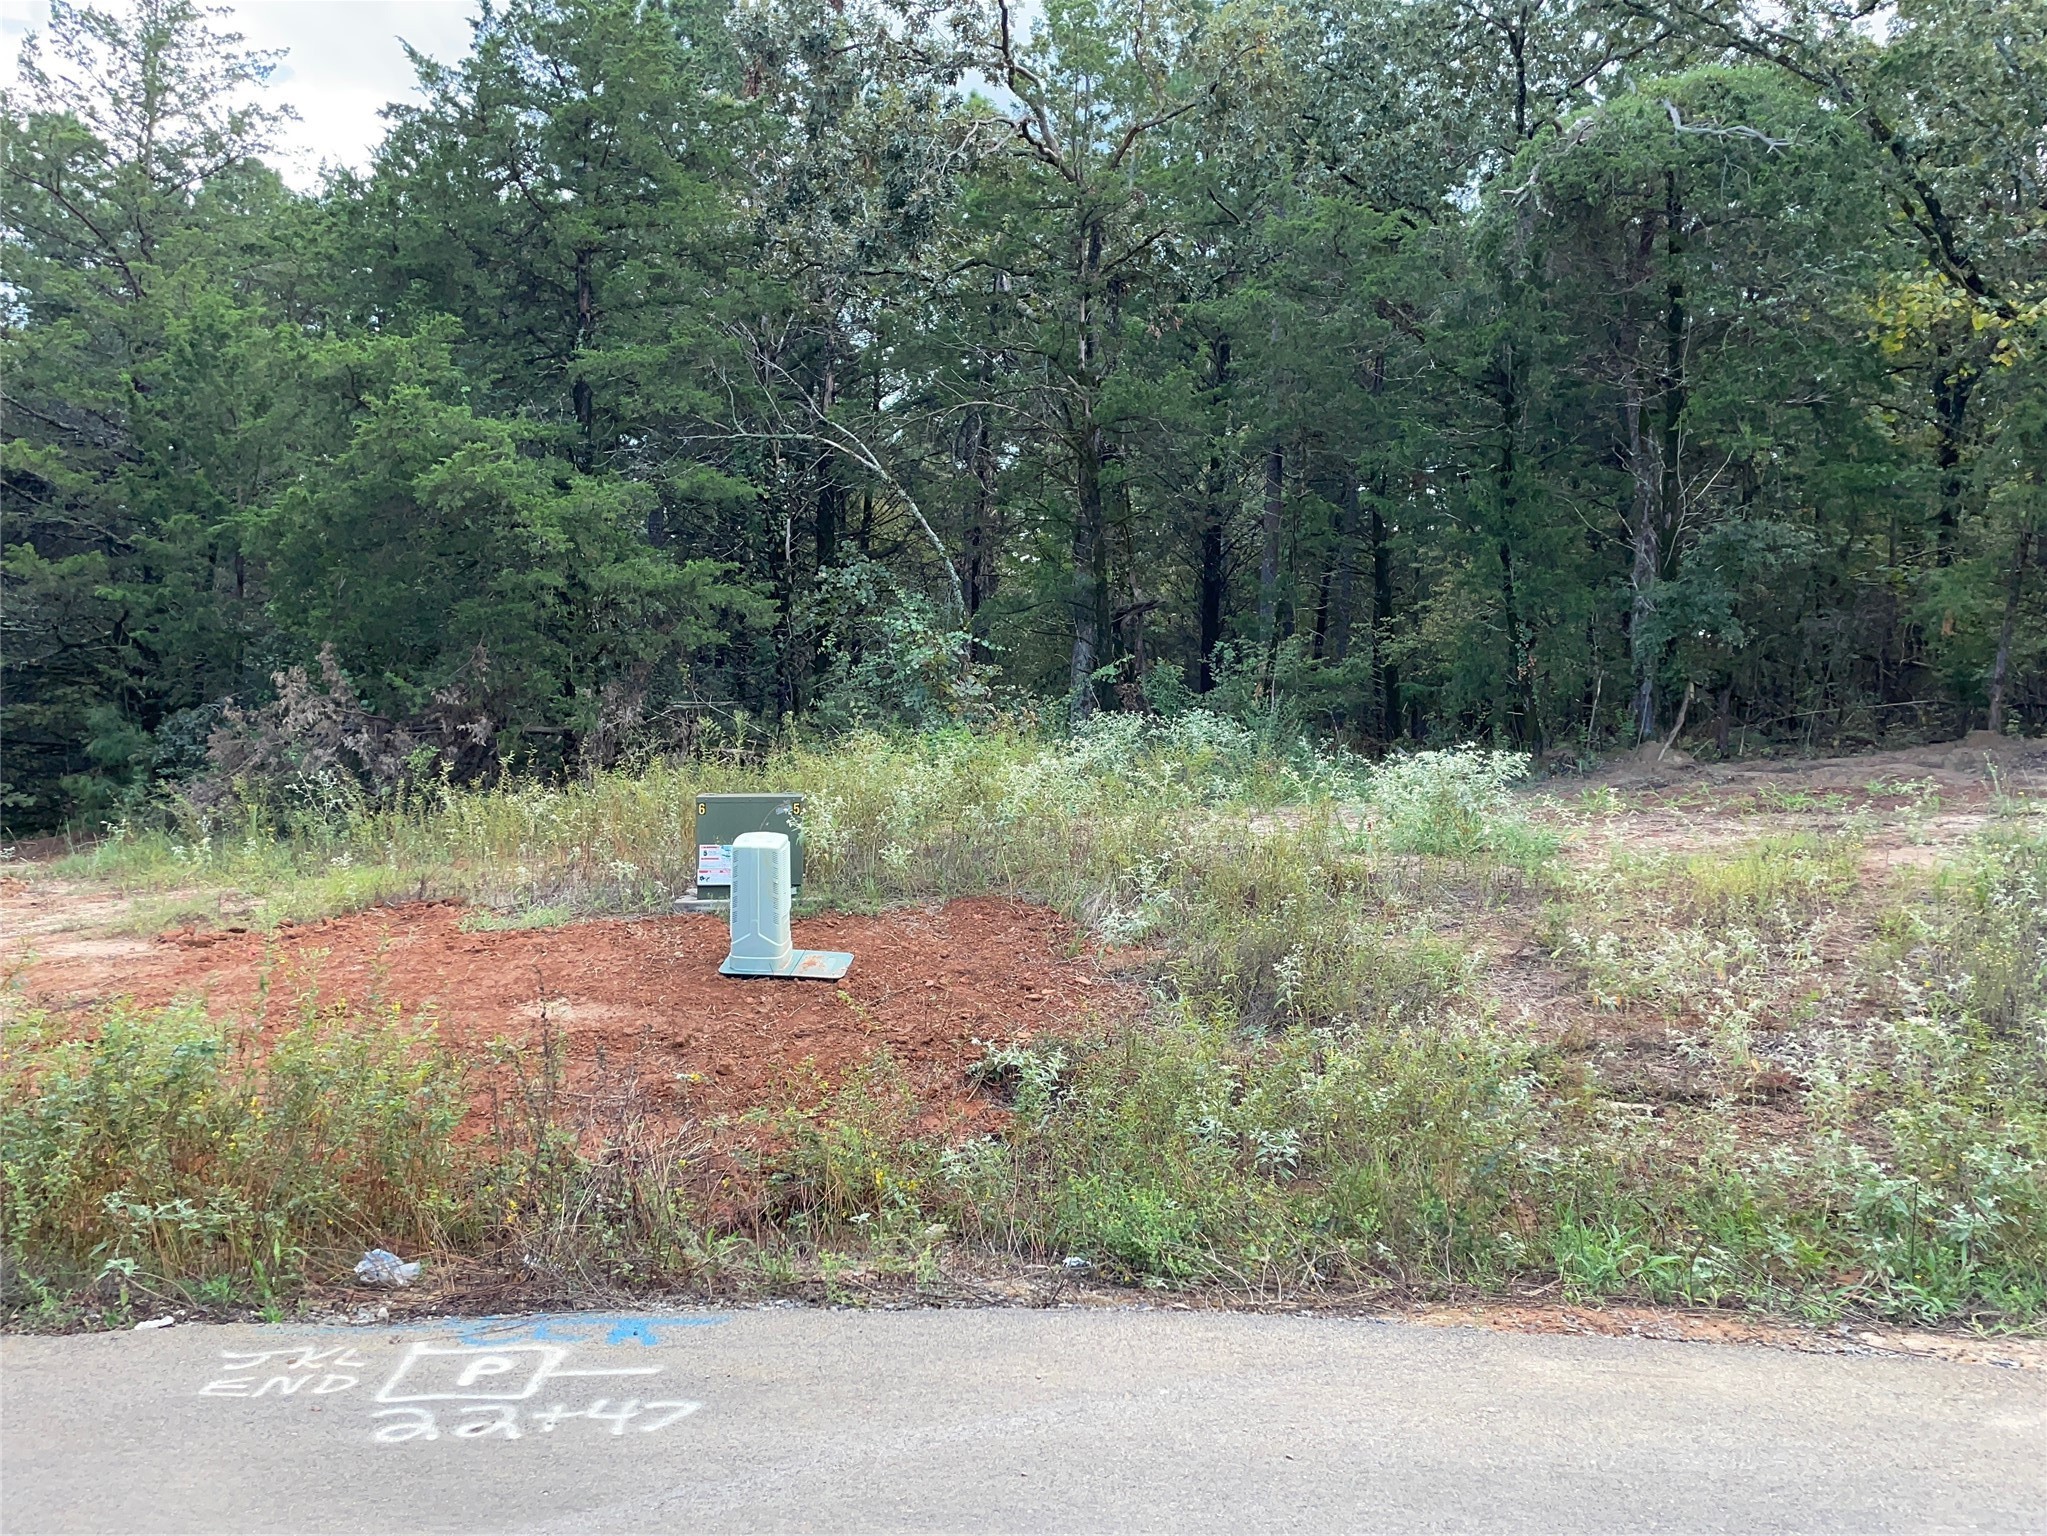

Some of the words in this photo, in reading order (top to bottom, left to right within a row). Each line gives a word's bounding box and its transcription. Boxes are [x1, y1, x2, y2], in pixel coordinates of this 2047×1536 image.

[697, 803, 706, 815] 6
[792, 803, 801, 815] 5
[458, 1356, 513, 1387] P
[199, 1374, 360, 1397] END
